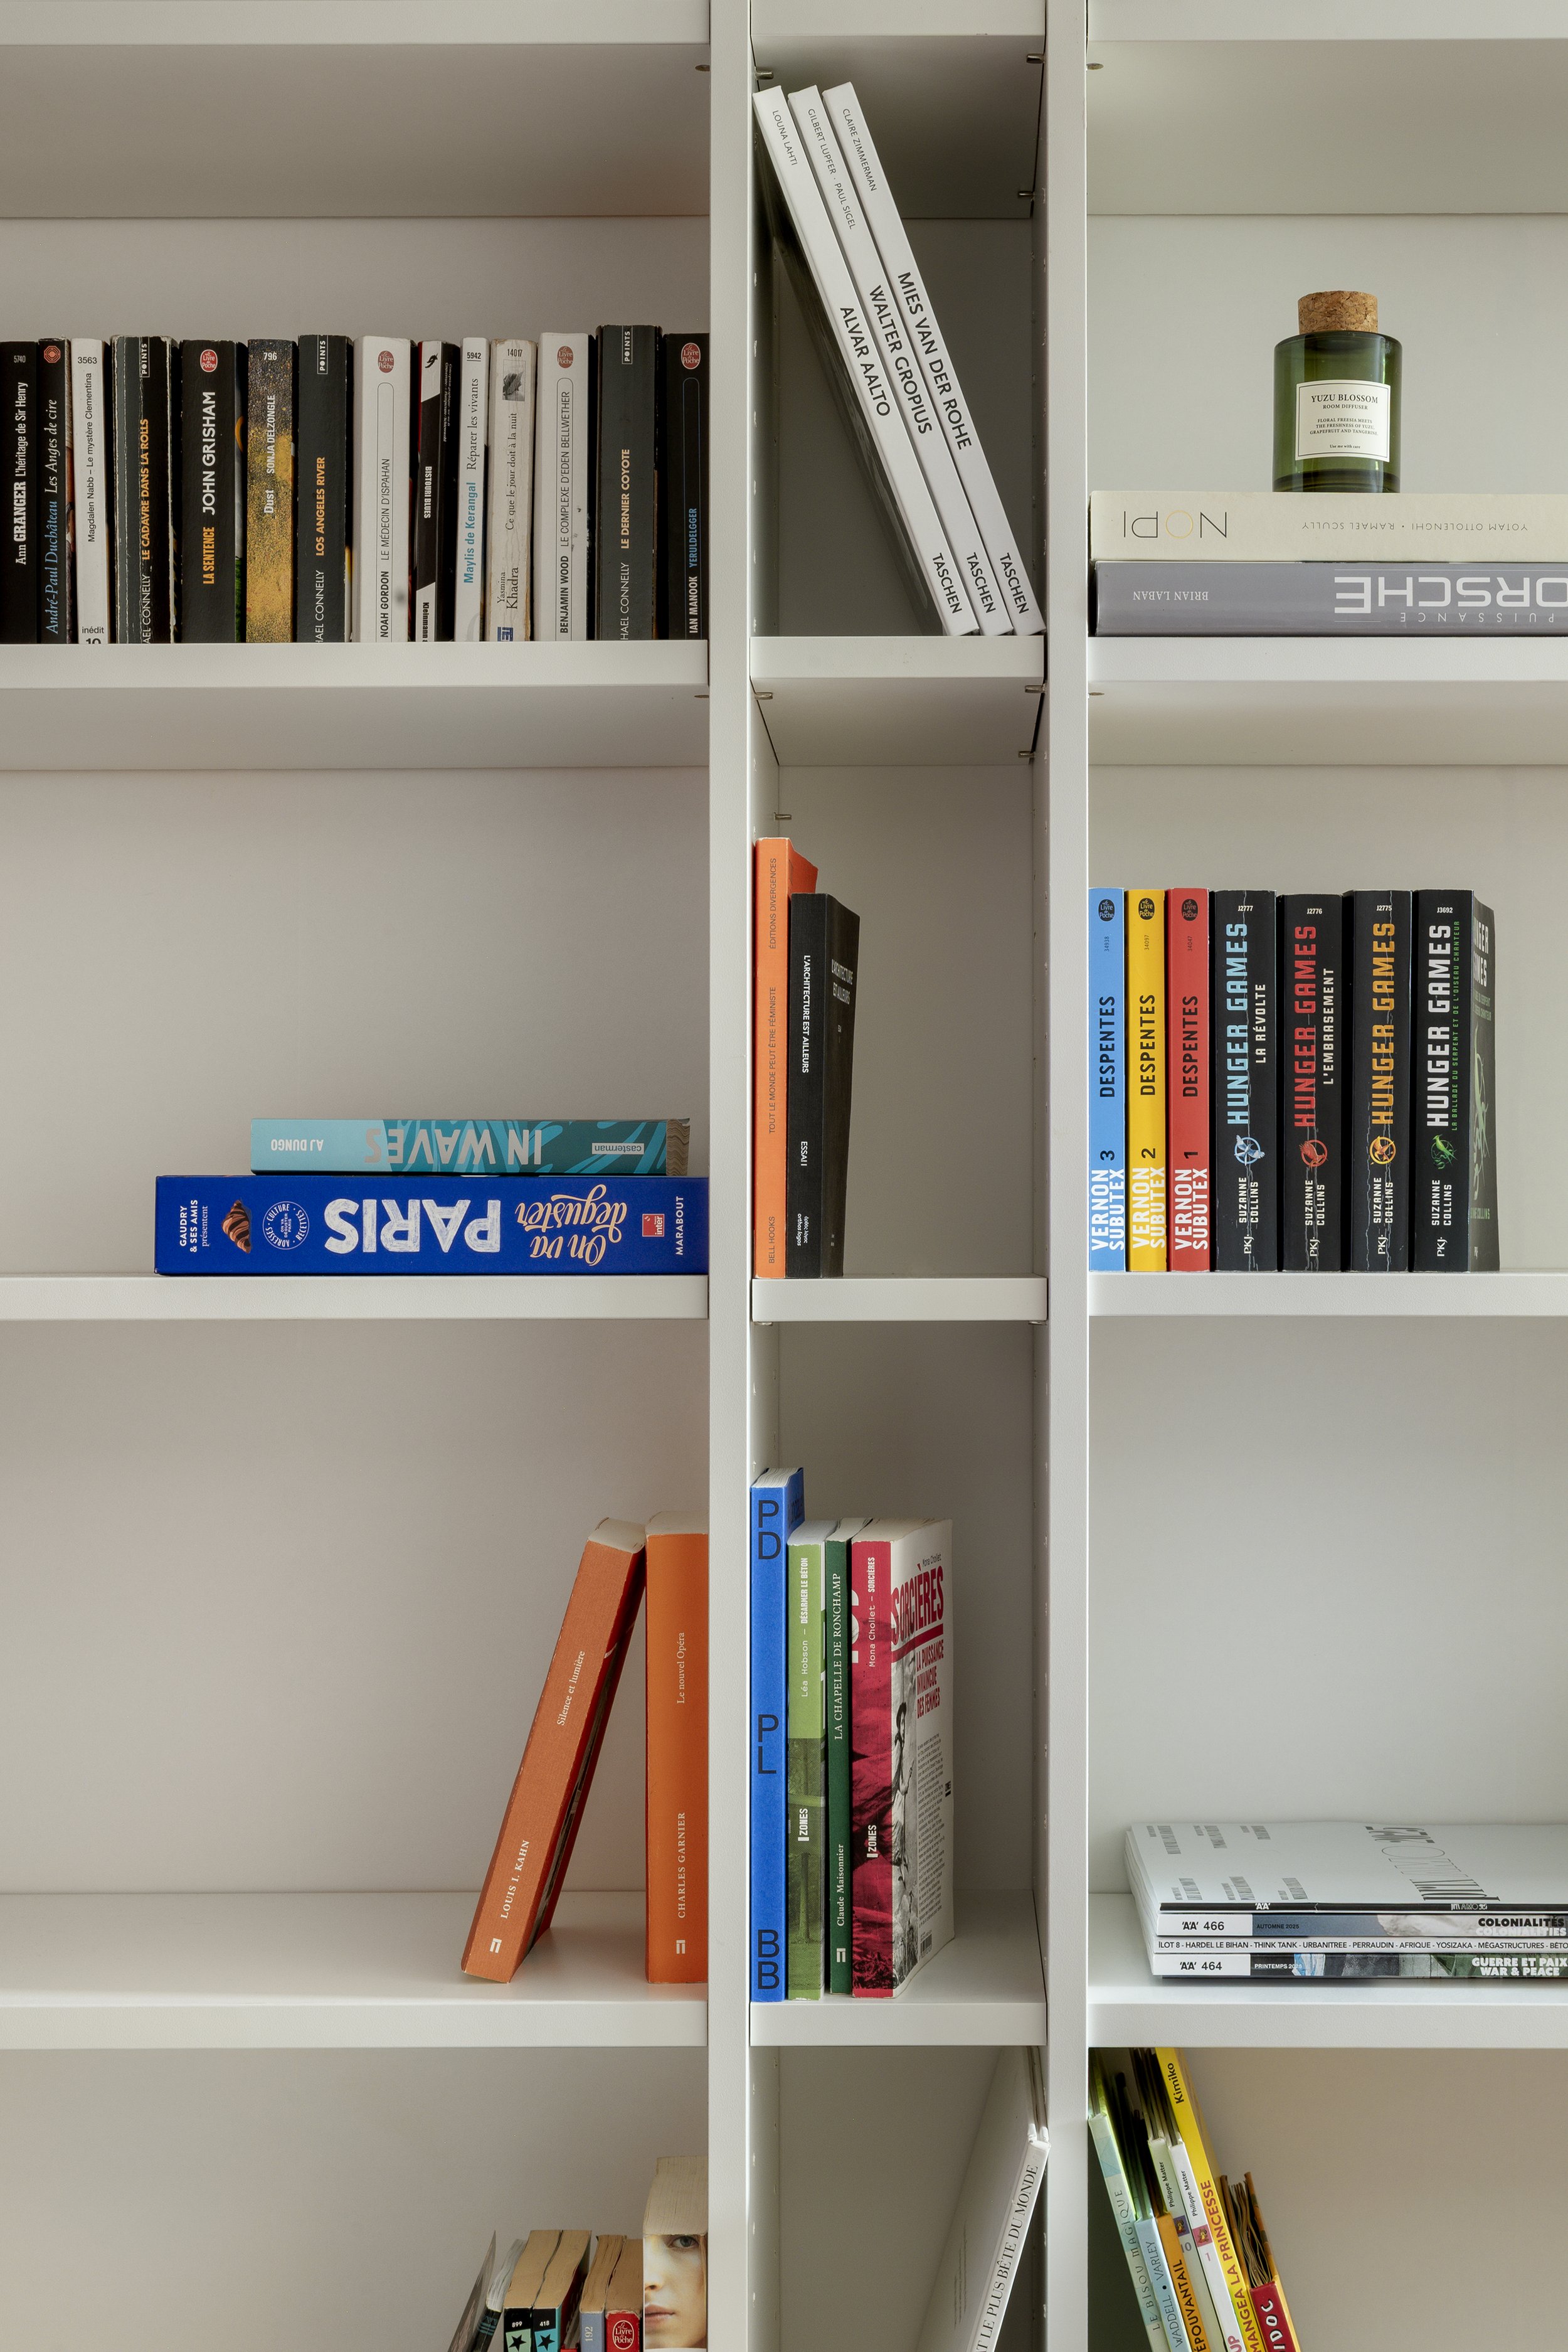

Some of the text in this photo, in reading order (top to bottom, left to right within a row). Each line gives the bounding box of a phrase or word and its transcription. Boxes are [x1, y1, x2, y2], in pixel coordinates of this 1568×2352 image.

[842, 109, 877, 191] CLAIRE ZIMMERMAN
[14, 355, 26, 363] 5740
[263, 352, 277, 361] 796
[467, 352, 482, 360] 5942
[840, 307, 891, 417] ALVAR AALTO
[869, 285, 933, 434] WALTER GROPIUS
[898, 272, 972, 450] MIES VAN DER ROHE
[467, 378, 480, 470] Réparer les vivants
[1311, 394, 1379, 403] YUZU BLOSSOM
[13, 382, 28, 565] Ann GRANGER L'héritage de Sir Henry
[85, 373, 97, 542] Magdalen Nabb Le mystère Clementina
[203, 392, 215, 515] JOHN GRISHAM
[43, 399, 60, 634] André-Paul Duchâteau Les Anges de cire
[315, 457, 325, 556] LOS ANGELES RIVER
[379, 459, 390, 560] LE MÉDECIN D'ISPAHAN
[621, 449, 630, 549] LE DERNIER COYOTE
[1124, 510, 1227, 540] NOPI
[1302, 522, 1528, 531] YOTAM OTTOLENGHI RAMAEL SCULLY
[203, 527, 215, 585] LA SENTENCE
[464, 482, 478, 583] Maylis de Kerangal
[689, 508, 697, 568] YERULDELGGER
[380, 571, 389, 637] NOAH GORDON
[933, 553, 963, 614] TASCHEN
[967, 552, 996, 614] TASCHEN
[1000, 552, 1029, 614] TASCHEN
[1133, 591, 1209, 600] BRIAN LABAN
[1400, 612, 1554, 623] PUISSANCE
[803, 955, 811, 1020] L'ARCHITECTURE
[768, 1029, 776, 1048] ÊTRE
[802, 1036, 810, 1073] AILLEURS
[1099, 996, 1115, 1097] DESPENTES
[1140, 994, 1155, 1095] DESPENTES
[1182, 996, 1198, 1097] DESPENTES
[1226, 923, 1249, 1125] HUNGER GAMES
[1253, 984, 1266, 1063] LA RÉVOLTE
[1295, 925, 1316, 1127] HUNGER GAMES
[1323, 968, 1334, 1085] L'EMBRASEMENT
[1372, 923, 1395, 1125] HUNGER GAMES
[1427, 925, 1451, 1127] HUNGER GAMES
[769, 1102, 776, 1111] LE
[271, 1139, 324, 1152] AJ DUNGO
[364, 1127, 542, 1165] IN WAVES
[593, 1144, 642, 1153] casterman
[324, 1198, 501, 1255] PARIS
[675, 1196, 684, 1255] MARABOUT
[1091, 1169, 1109, 1251] VERNON
[1110, 1168, 1125, 1251] SUBUTEX
[1133, 1168, 1150, 1248] VERNON
[1150, 1166, 1165, 1248] SUBUTEX
[1175, 1169, 1192, 1251] VERNON
[1192, 1168, 1208, 1251] SUBUTEX
[1239, 1176, 1247, 1223] SUZANNE
[1250, 1181, 1258, 1223] COLLINS
[1432, 1179, 1440, 1226] SUZANNE
[800, 1558, 808, 1624] DÉSARMER LE BÉTON
[833, 1573, 842, 1740] LA CHAPELLE DE RONCHAMP
[799, 1808, 808, 1836] ZONES
[501, 1839, 530, 1919] LOUIS I. KAHN
[836, 1844, 844, 1927] Claude Maisonnier
[1204, 1922, 1224, 1930] 466
[1478, 1916, 1564, 1927] COLONIALITÉS
[1201, 1962, 1222, 1971] 464
[1480, 1967, 1559, 1976] WAR & PEACE
[1166, 2062, 1184, 2104] Kimiko
[980, 2164, 1038, 2346] LE PLUS BÊTE DU MONDE
[1200, 2179, 1261, 2352] MANGEA LA PRINCESSE
[585, 2326, 593, 2342] 192
